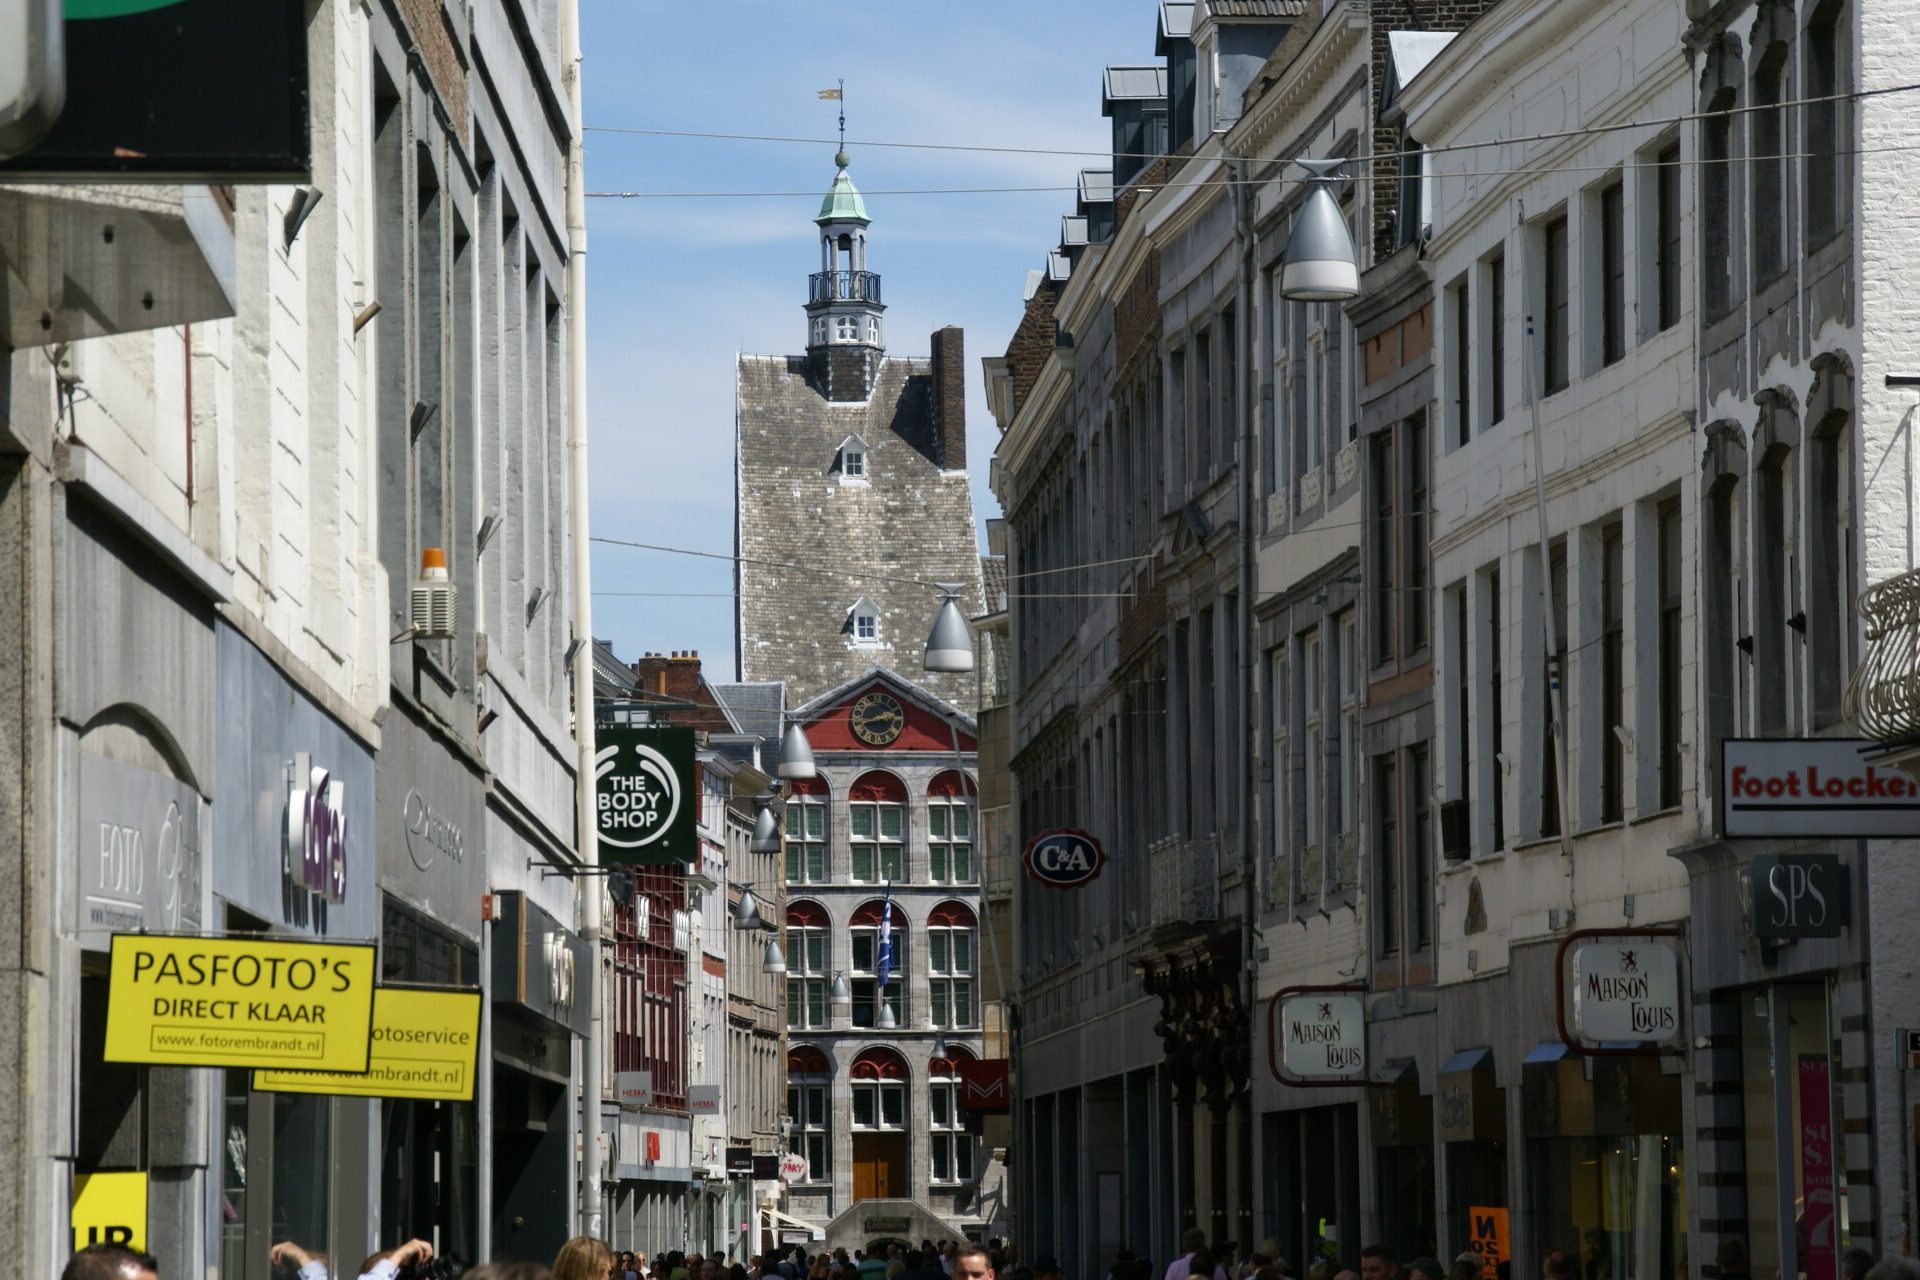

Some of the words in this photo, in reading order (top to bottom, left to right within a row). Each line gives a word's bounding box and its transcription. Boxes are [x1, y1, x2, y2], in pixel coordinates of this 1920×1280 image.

[609, 776, 645, 791] THE
[598, 792, 661, 810] BODY
[601, 811, 658, 828] SHOP
[100, 822, 144, 895] FOTO
[1040, 844, 1091, 871] C&A
[1769, 863, 1826, 927] SPS
[132, 951, 351, 992] PASFOTO'S
[153, 997, 240, 1020] DIRECT
[247, 1002, 326, 1024] KLAAR
[156, 1033, 320, 1052] www.fotorembrandt.nl
[371, 1027, 469, 1045] otoservice
[622, 1089, 647, 1097] HEMA
